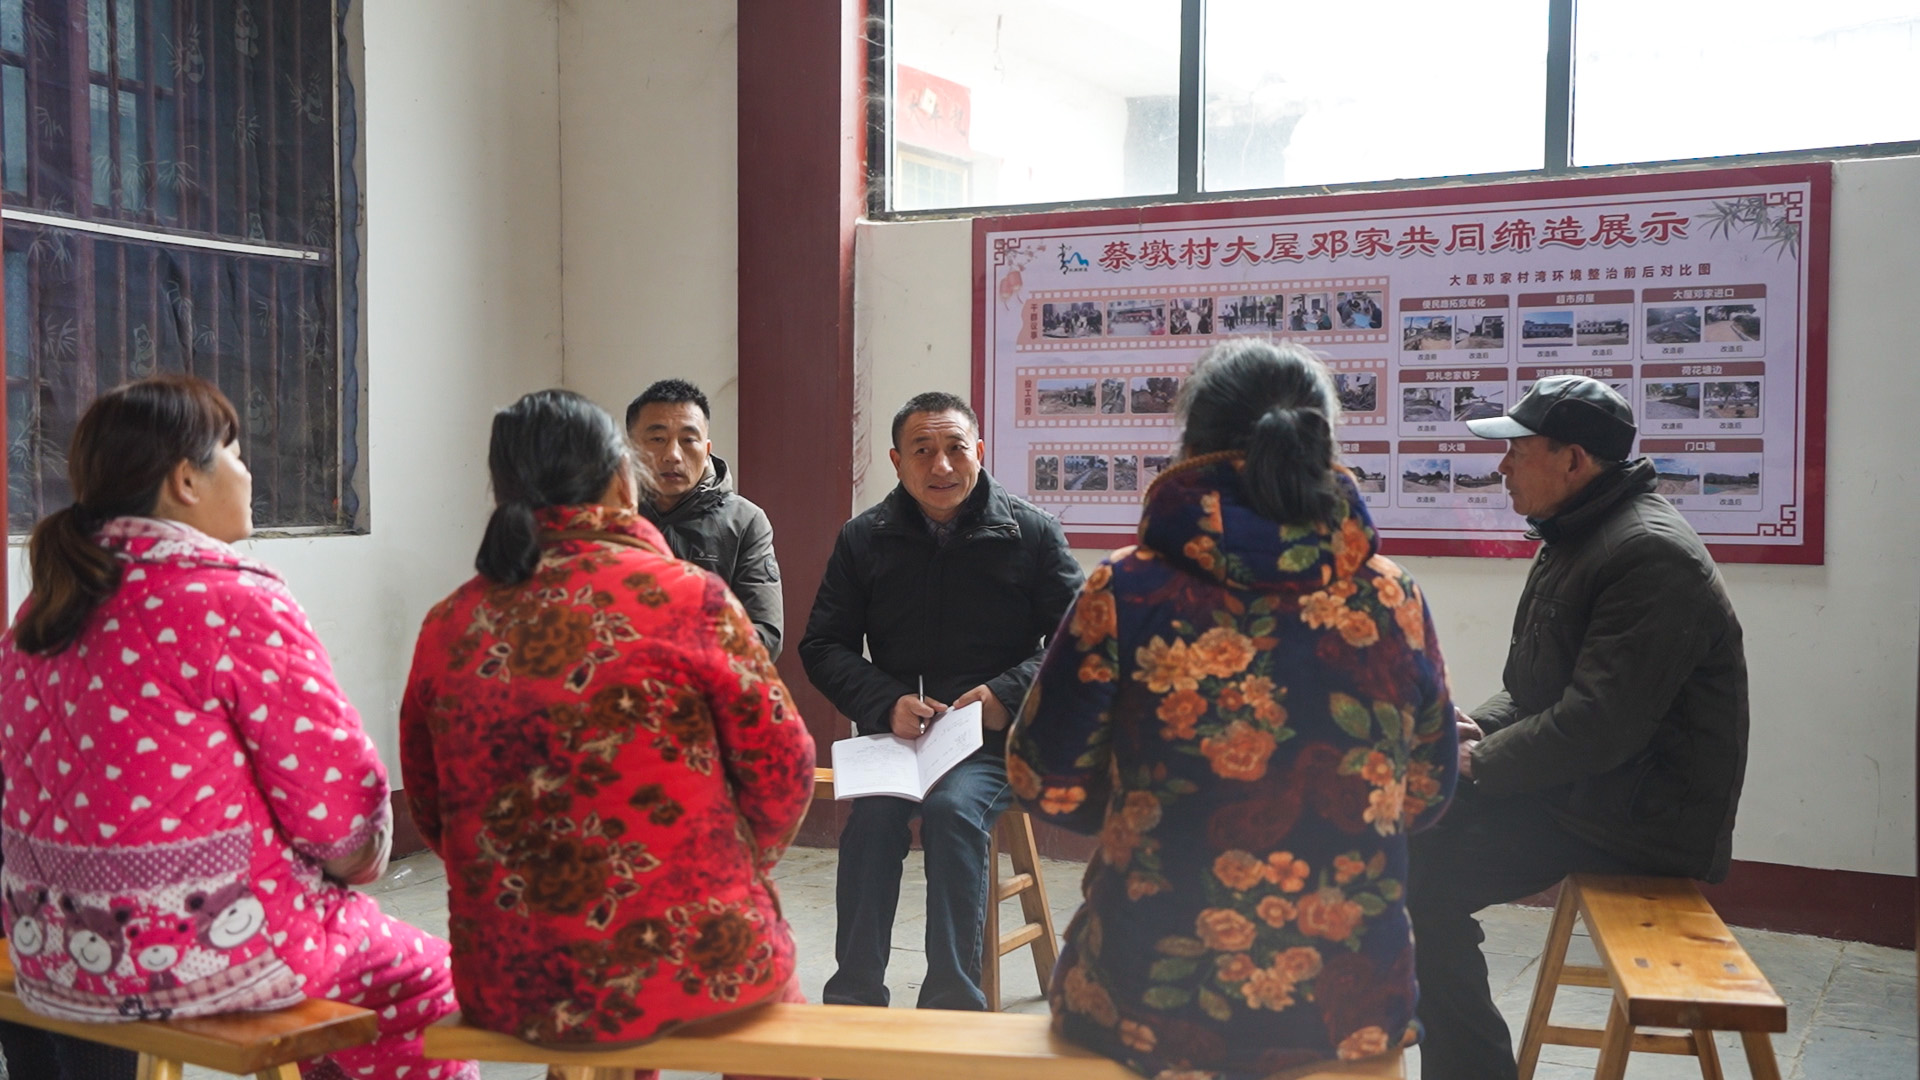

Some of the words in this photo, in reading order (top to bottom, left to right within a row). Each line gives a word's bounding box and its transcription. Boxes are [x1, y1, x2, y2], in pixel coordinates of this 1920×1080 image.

[1098, 211, 1690, 271] 蔡墩村大屋邓家共同缔造展示
[1449, 263, 1711, 286] 大屋邓家村湾环境整治前后对比图
[1556, 293, 1595, 304] 超市房屋
[1673, 288, 1735, 300] 大屋邓家进口
[1681, 365, 1722, 376] 荷花塘边
[1684, 441, 1716, 452] 门口塘
